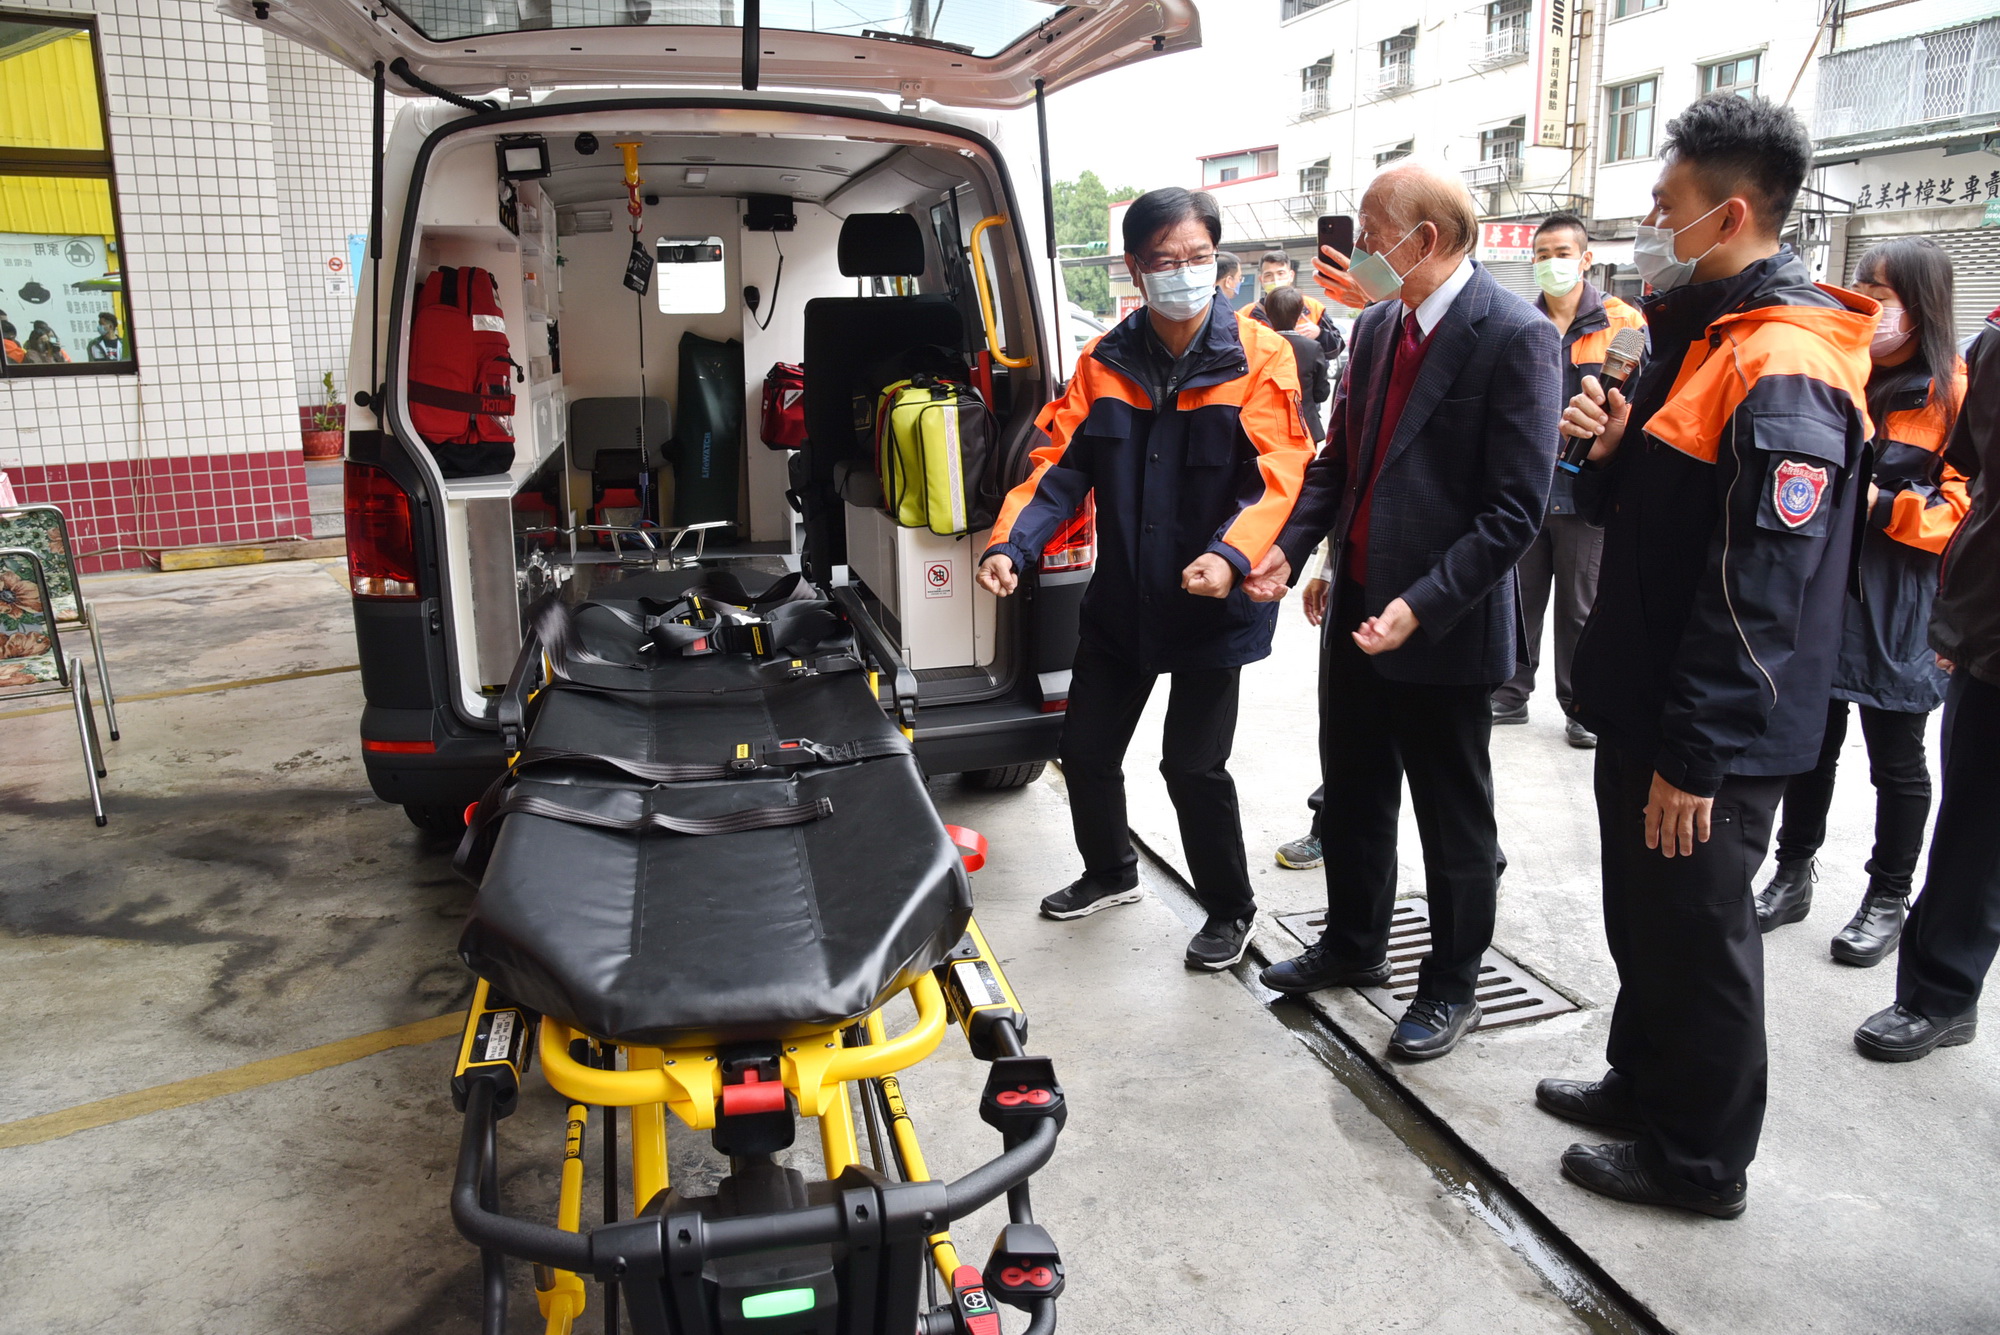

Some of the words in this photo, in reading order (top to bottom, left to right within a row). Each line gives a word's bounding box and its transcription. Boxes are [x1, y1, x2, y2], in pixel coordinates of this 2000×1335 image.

[1548, 47, 1560, 110] 普利司通輪胎
[1856, 170, 2000, 210] 亞美牛樟芝專賣
[702, 432, 711, 478] LifeWATCH
